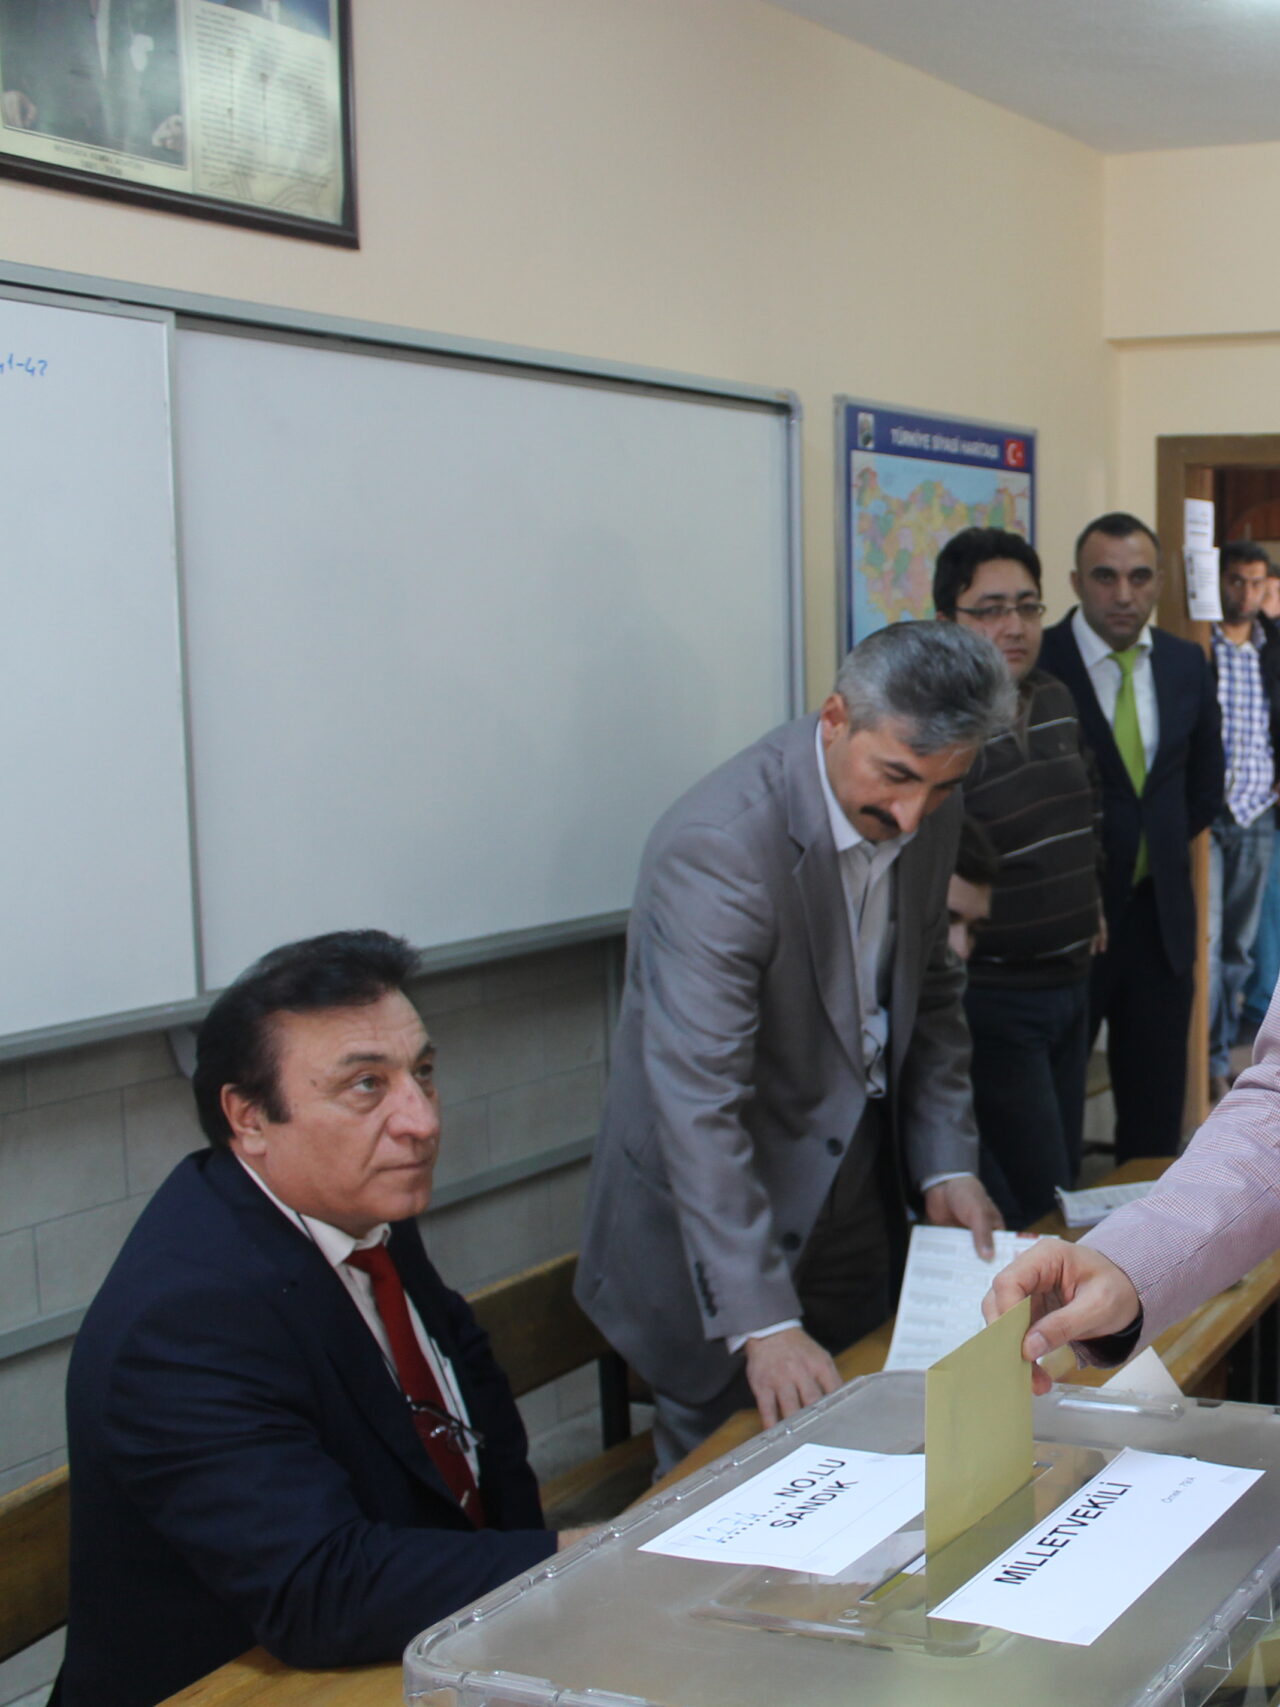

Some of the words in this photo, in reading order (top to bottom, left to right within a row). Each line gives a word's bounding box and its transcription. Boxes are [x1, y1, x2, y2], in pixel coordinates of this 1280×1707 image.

[773, 1458, 847, 1498] NO.LU
[769, 1479, 859, 1529] SANDIK
[993, 1481, 1133, 1585] MİLLETVEKİLİ
